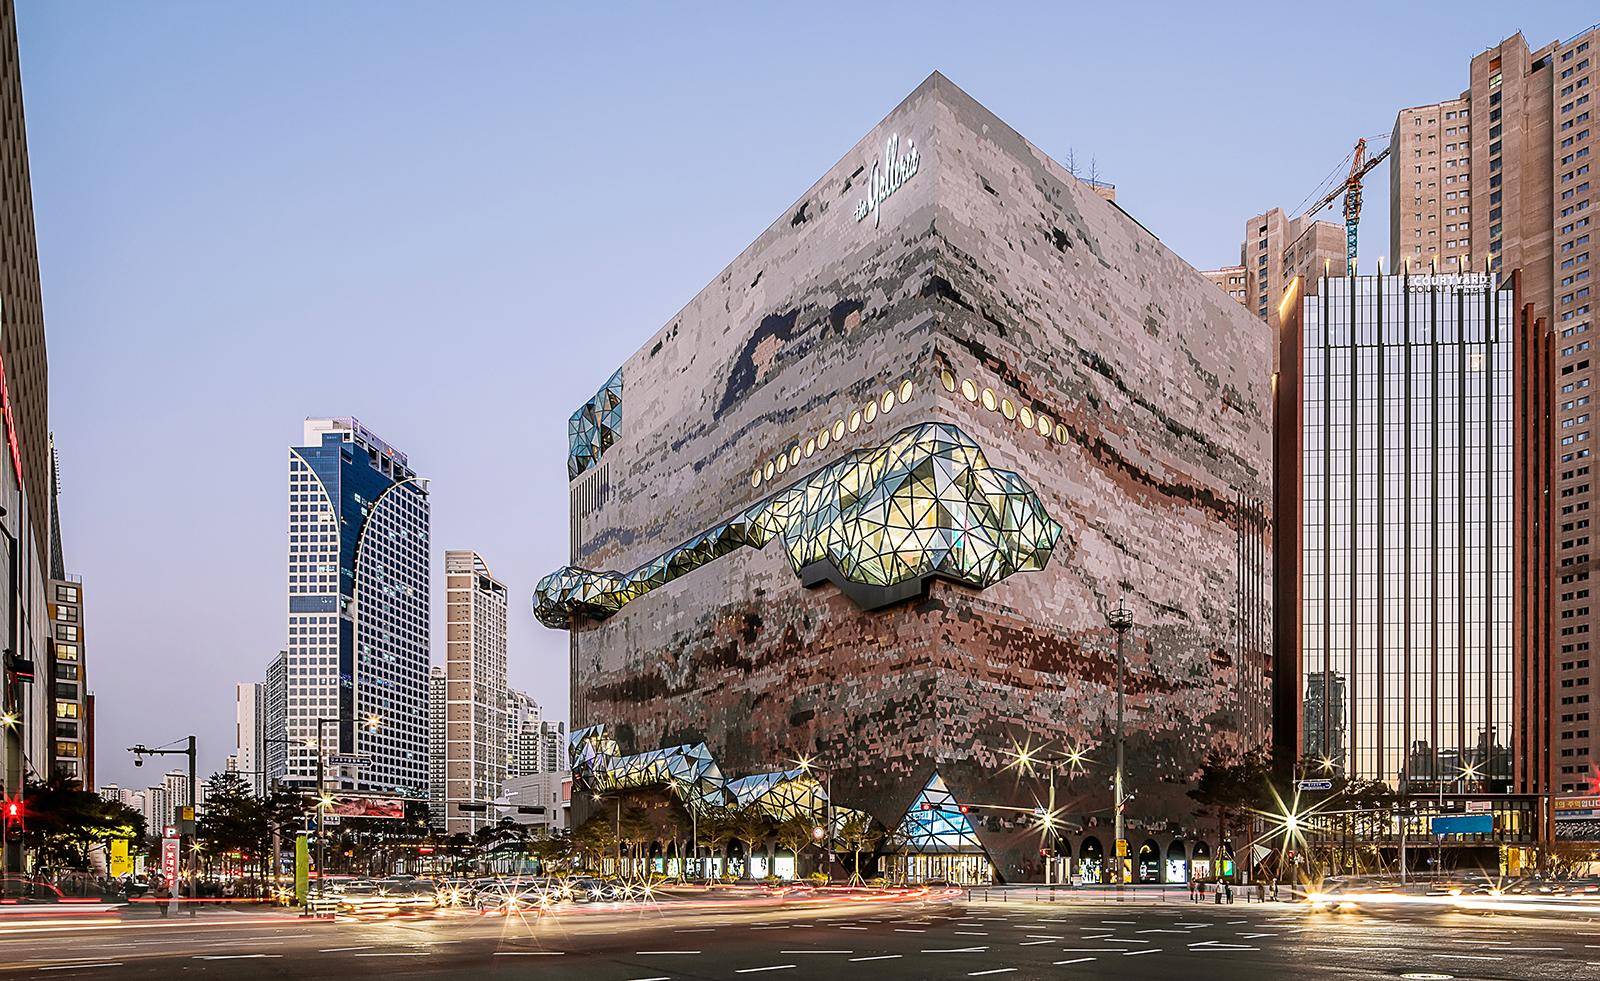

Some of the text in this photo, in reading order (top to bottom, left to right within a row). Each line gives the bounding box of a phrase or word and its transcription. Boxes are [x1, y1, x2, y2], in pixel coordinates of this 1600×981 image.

[867, 132, 920, 229] Galleria
[1414, 275, 1488, 285] COURTYARD
[166, 828, 176, 839] P
